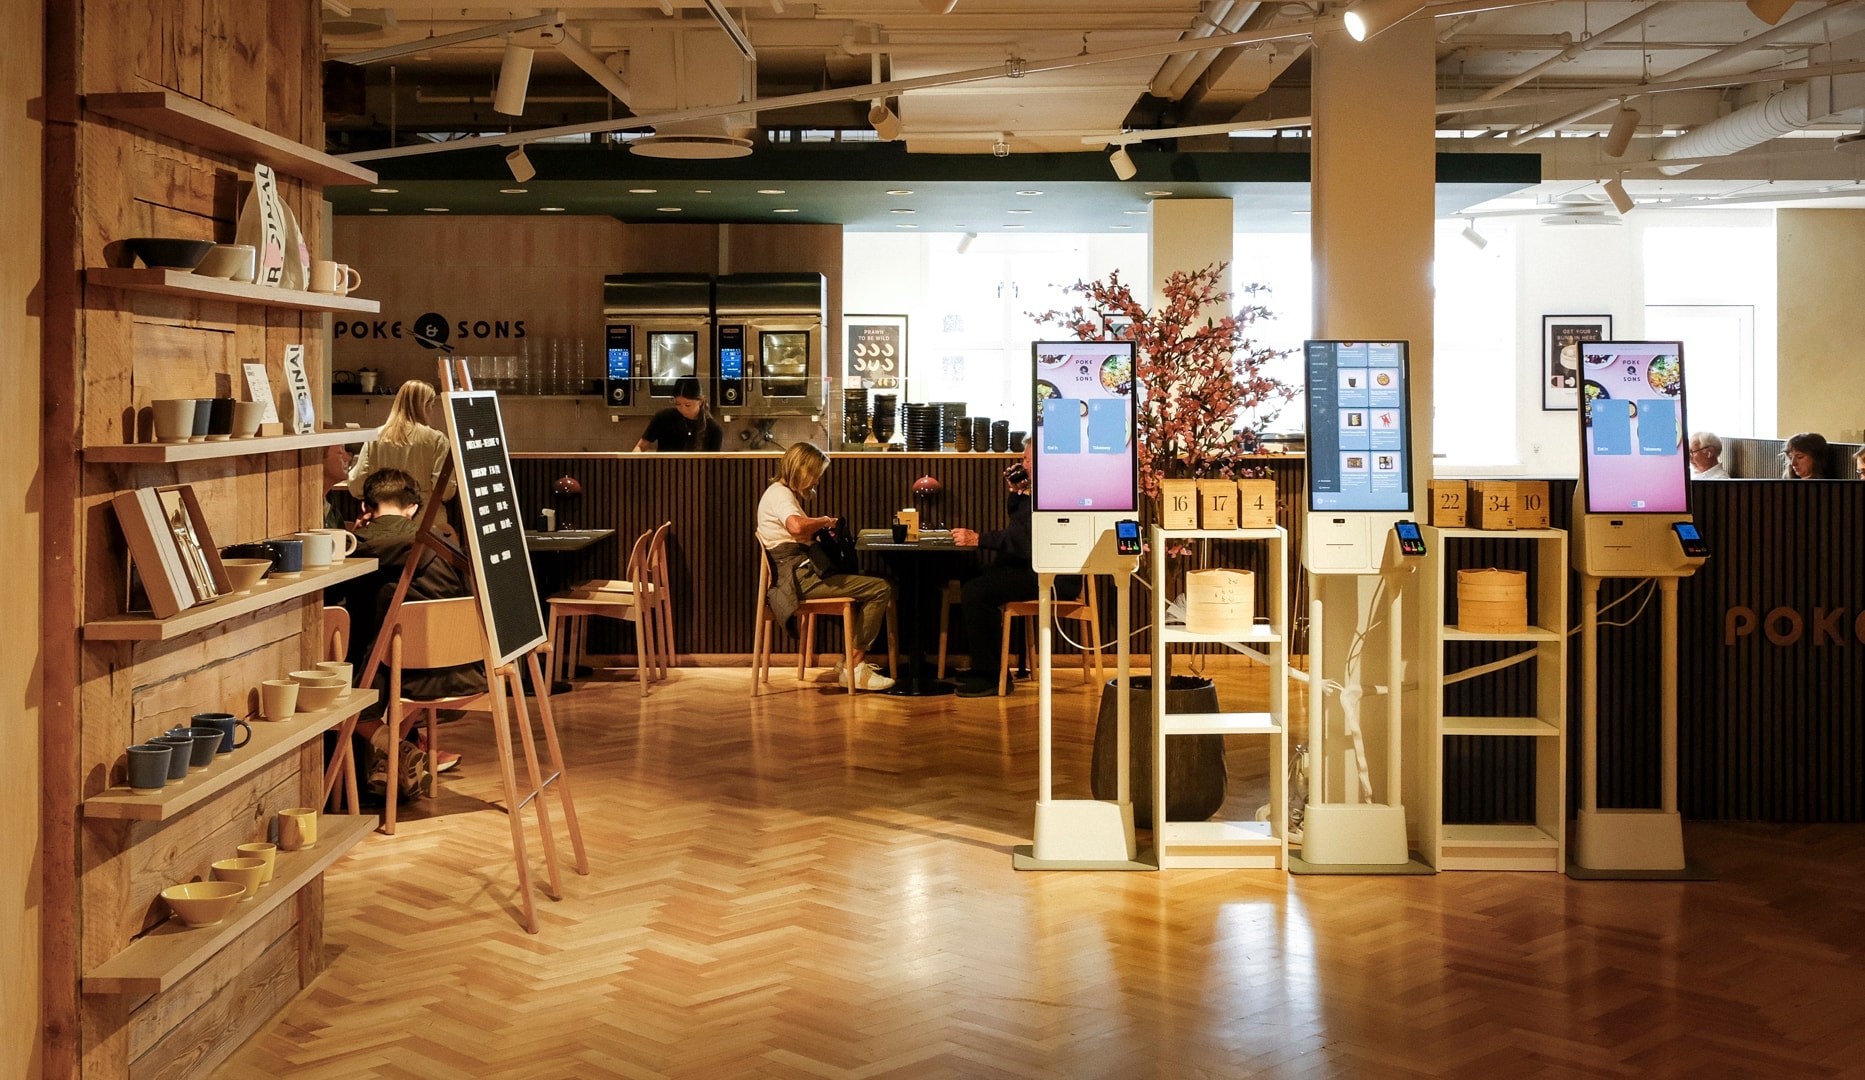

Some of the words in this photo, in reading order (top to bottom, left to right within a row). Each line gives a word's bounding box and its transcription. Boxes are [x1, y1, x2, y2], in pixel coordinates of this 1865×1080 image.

[335, 321, 402, 339] POKE
[458, 321, 526, 339] SONS
[1173, 495, 1188, 512] 16
[1212, 495, 1228, 511] 17
[1254, 495, 1264, 510] 4
[1441, 493, 1460, 510] 22
[1489, 495, 1510, 511] 34
[1524, 494, 1541, 510] 10
